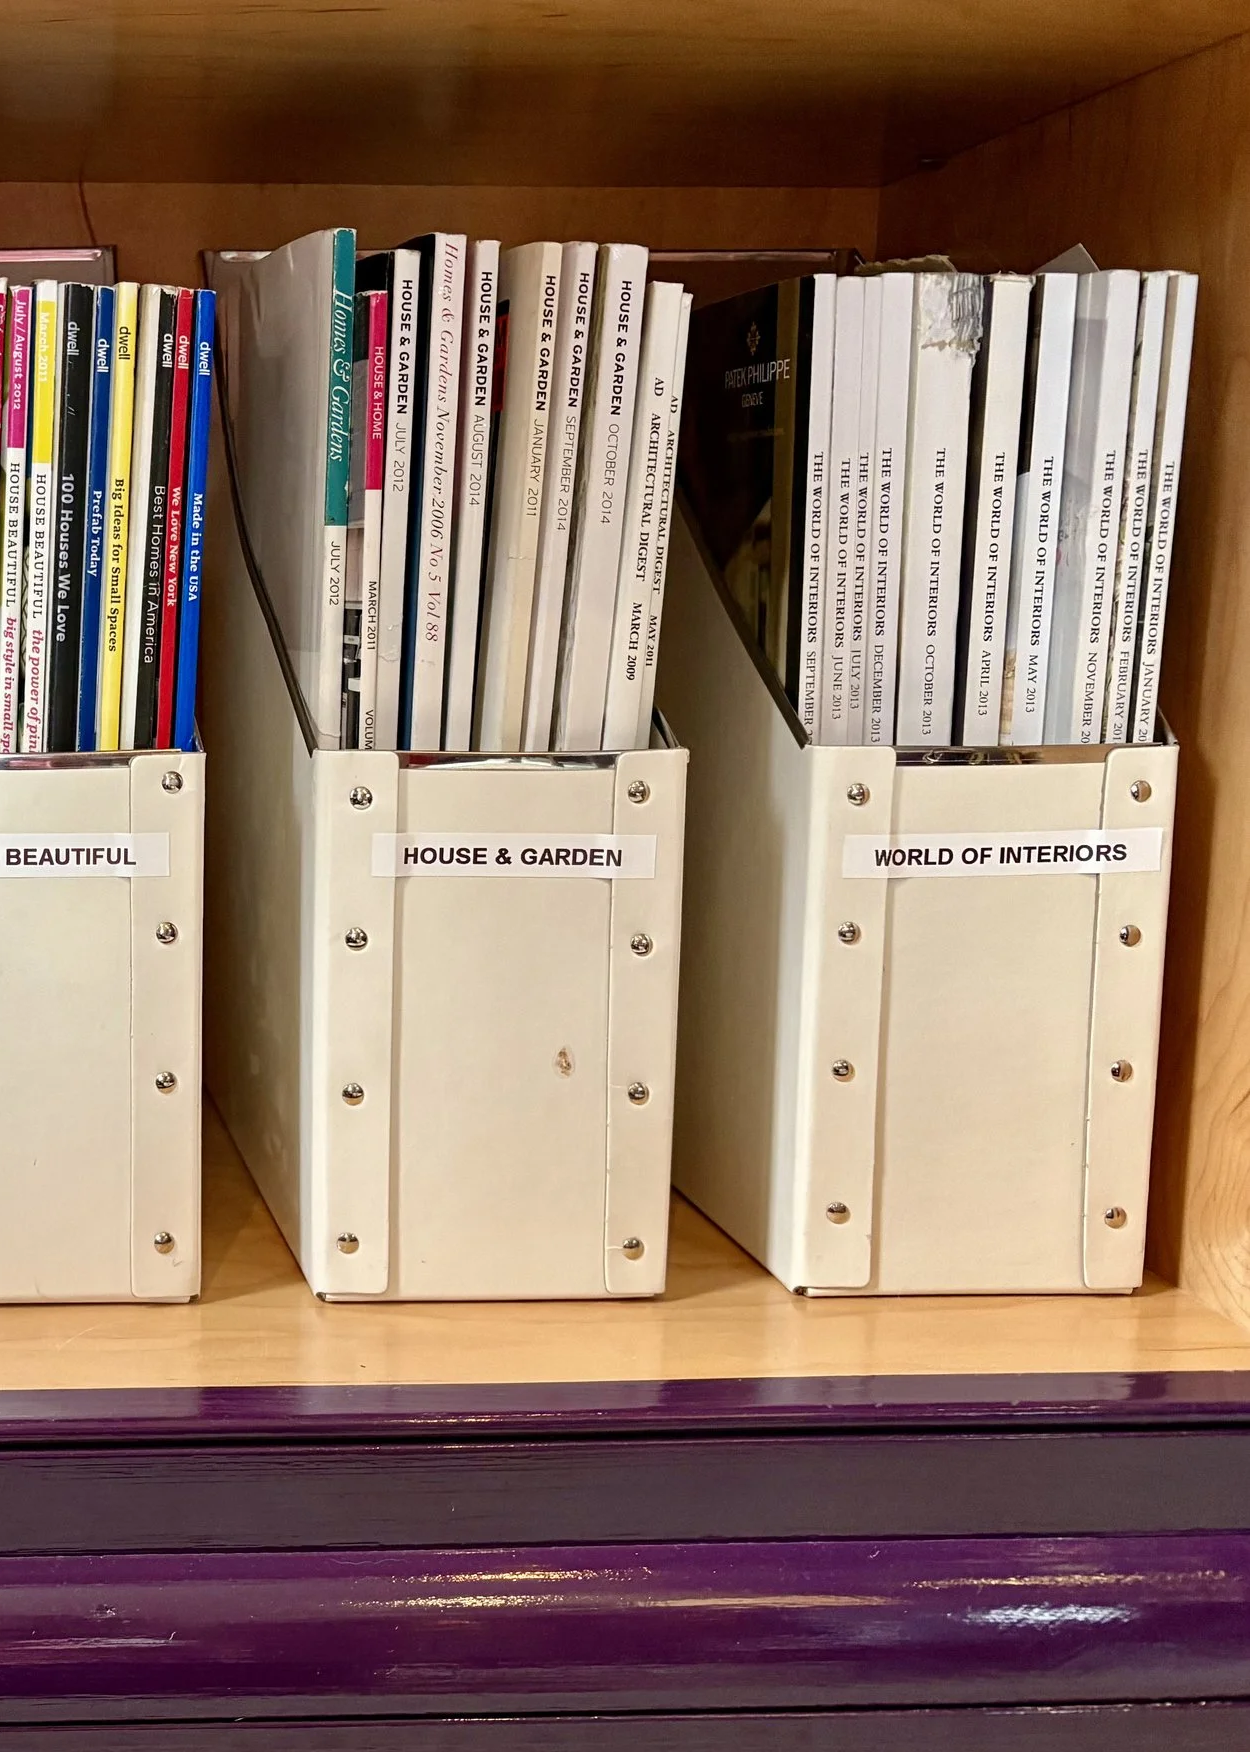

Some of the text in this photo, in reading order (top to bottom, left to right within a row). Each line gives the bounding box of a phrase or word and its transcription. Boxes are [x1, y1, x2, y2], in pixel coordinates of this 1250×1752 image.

[56, 322, 79, 641] dwell 100 Houses We Love
[107, 327, 130, 652] dwell Big Ideas for Small Spaces
[188, 342, 210, 601] dwell Made in the USA
[330, 290, 352, 605] Homes & Gardens JULY 2012
[367, 346, 383, 649] HOUSE & HOME MARCH 2011
[431, 243, 458, 539] Homes & Gardens November 2006
[601, 281, 632, 524] HOUSE & GARDEN OCTOBER 2014
[625, 377, 664, 680] AD ARCHITECTURAL DIGEST MARCH 2009
[871, 448, 892, 742] THE WORLD OF INTERIORS DECEMBER 2013
[922, 448, 946, 735] THE WORLD OF INTERIORS OCTOBER 2013
[978, 452, 1005, 716] THE WORLD OF INTERIORS APRIL 2013
[5, 847, 137, 867] BEAUTIFUL
[403, 847, 623, 867] HOUSE & GARDEN
[874, 843, 1127, 867] WORLD OF INTERIORS
